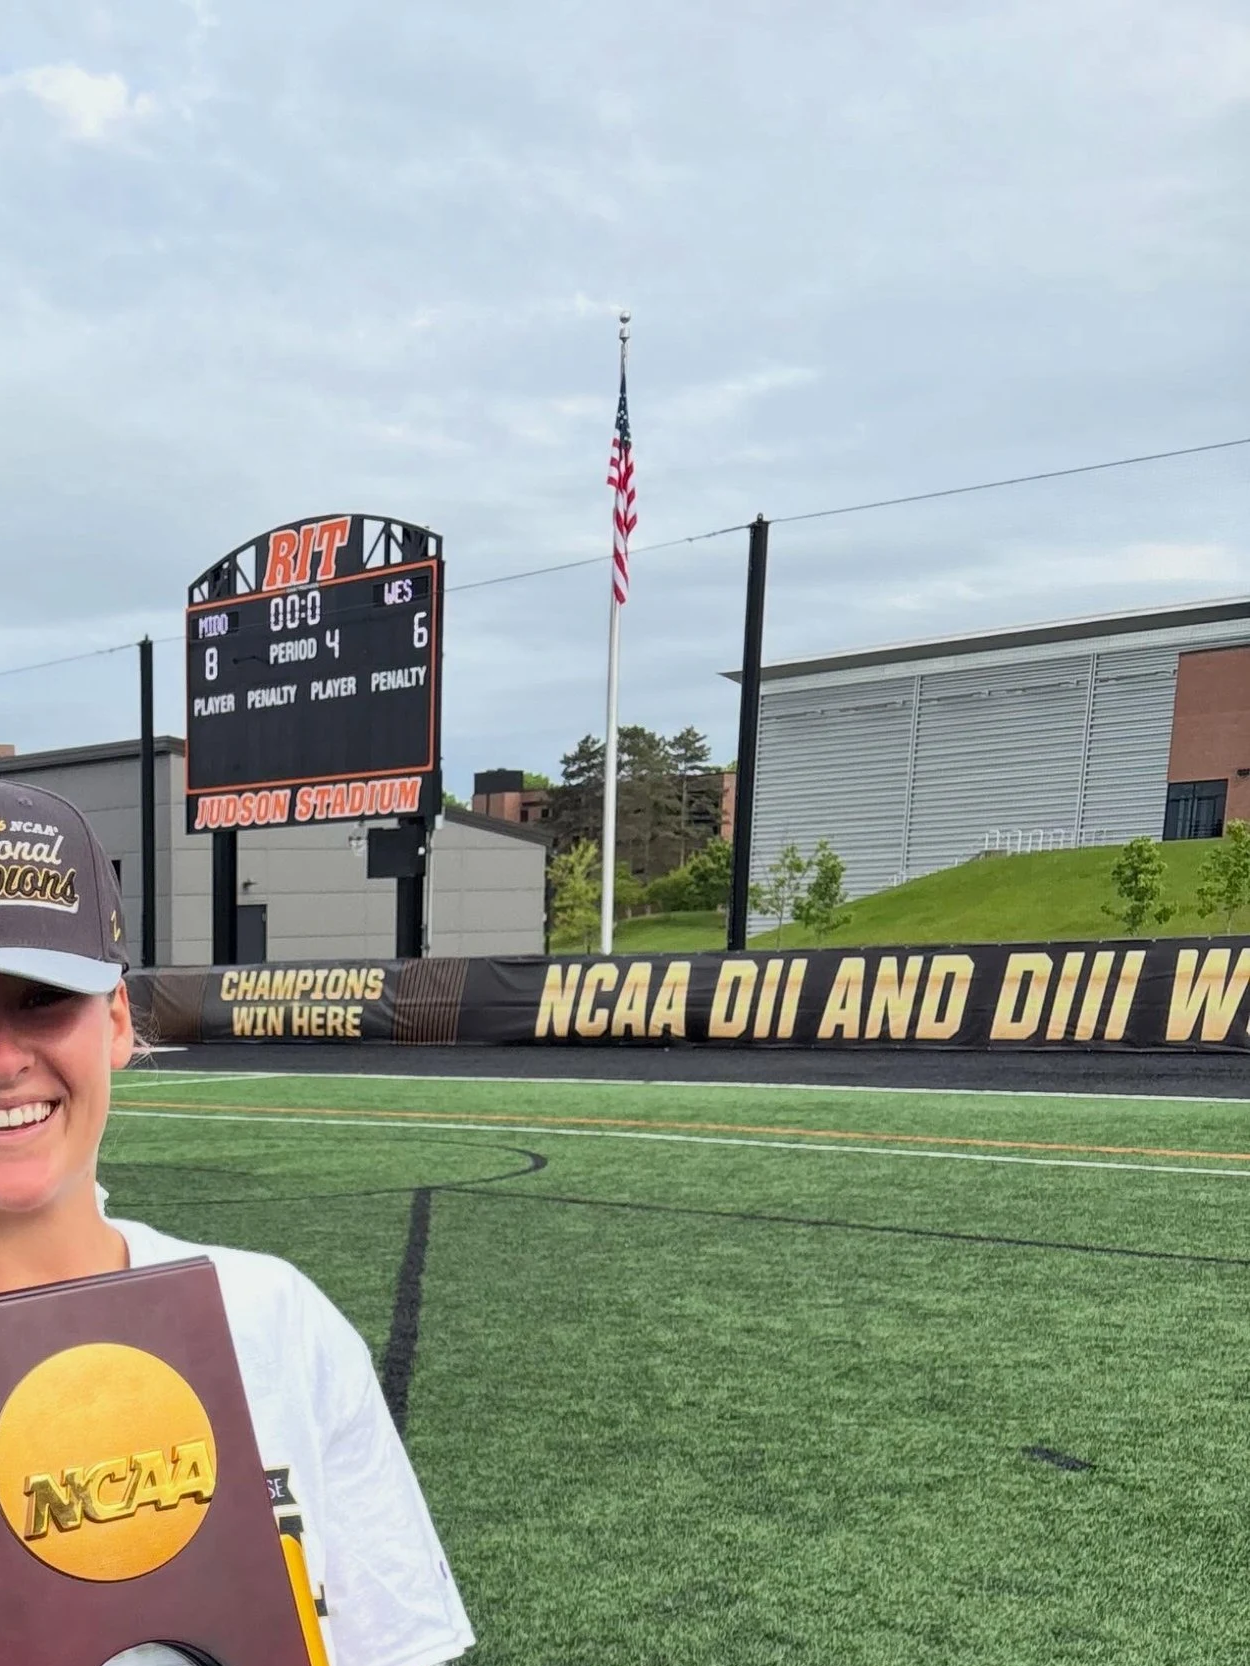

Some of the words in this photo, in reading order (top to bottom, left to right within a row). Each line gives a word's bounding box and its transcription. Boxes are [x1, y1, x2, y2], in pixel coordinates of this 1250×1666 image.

[262, 516, 351, 591] RIT
[270, 590, 321, 632] 00:0
[384, 578, 413, 605] WES
[269, 637, 318, 665] PERIOD
[325, 628, 340, 659] 4
[413, 611, 428, 649] 6
[205, 646, 219, 681] 8
[194, 694, 236, 717] PLAYER
[247, 684, 298, 710] PENALTY
[310, 676, 357, 701] PLAYER
[371, 665, 428, 693] PENALTY
[195, 789, 291, 830] JUDSON
[295, 777, 422, 821] STADIUM
[220, 967, 385, 1001] CHAMPIONS
[535, 961, 691, 1038] NCAA
[708, 957, 808, 1039] DII
[817, 954, 975, 1040] AND
[989, 949, 1147, 1041] DIII
[1165, 947, 1250, 1042] W
[232, 1006, 285, 1037] WIN
[291, 1003, 364, 1037] HERE
[23, 1438, 216, 1541] NCAA
